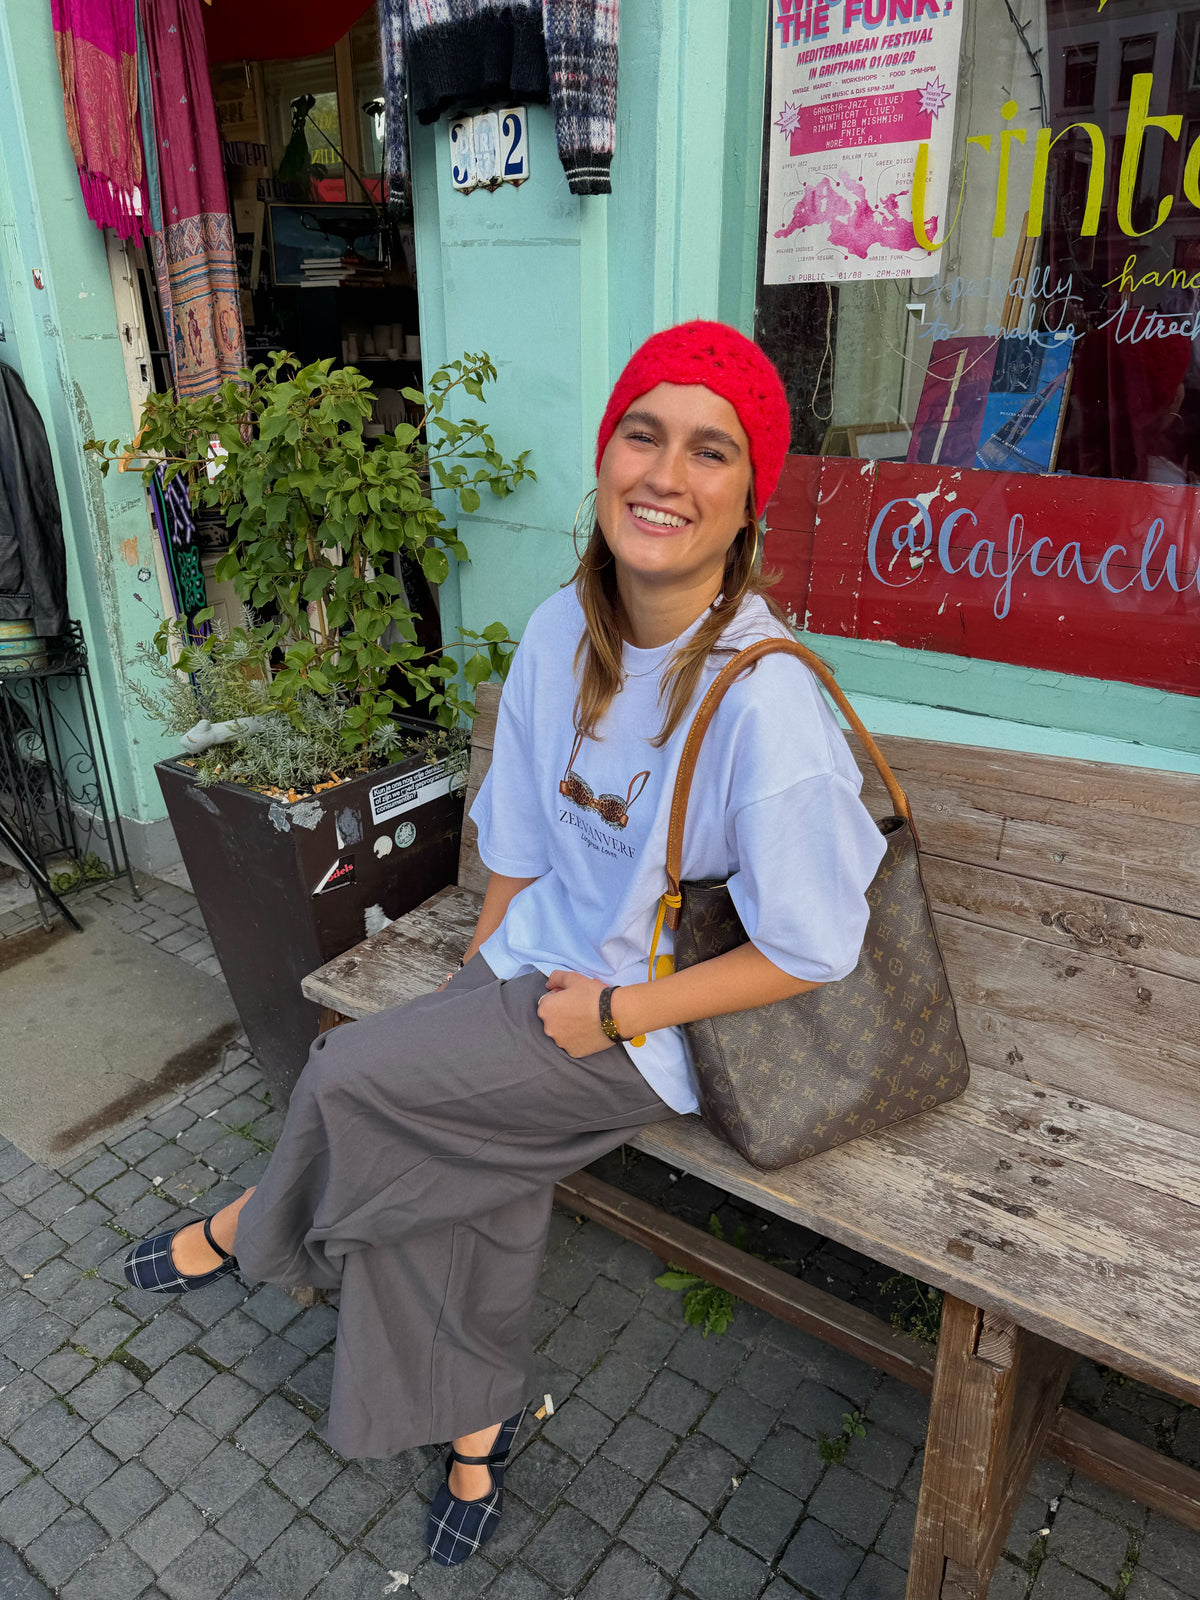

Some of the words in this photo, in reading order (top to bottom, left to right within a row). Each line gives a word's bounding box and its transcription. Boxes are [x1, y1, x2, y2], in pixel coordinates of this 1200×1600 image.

[776, 4, 829, 46] THE
[796, 37, 879, 65] MEDITERRANEAN
[881, 28, 933, 48] FESTIVAL
[808, 67, 817, 80] IN
[819, 57, 868, 78] GRIFTPARK
[792, 86, 809, 95] VINTAGE
[813, 82, 832, 91] MARKET
[841, 74, 878, 85] WORKSHOPS
[889, 70, 905, 78] FOOD
[832, 90, 850, 99] MUSIC
[855, 88, 866, 96] DJS
[813, 99, 867, 116] GANGSTA-JAZZ
[873, 94, 904, 107] (LIVE)
[819, 110, 859, 124] SYNTHICAT
[865, 105, 896, 117] (LIVE)
[813, 122, 837, 134] RIMINI
[841, 119, 857, 129] B2B
[861, 114, 904, 126] MISHMISH
[841, 127, 866, 138] FNIEK
[825, 139, 843, 149] MORE
[896, 157, 913, 165] DISCO
[799, 273, 825, 281] PUBLIC
[838, 271, 862, 280] 01/08
[876, 269, 911, 278] 2PM-2AM
[920, 315, 964, 341] to
[984, 303, 1086, 348] make
[373, 788, 384, 796] Kun
[402, 777, 412, 785] nog
[328, 864, 354, 882] odels
